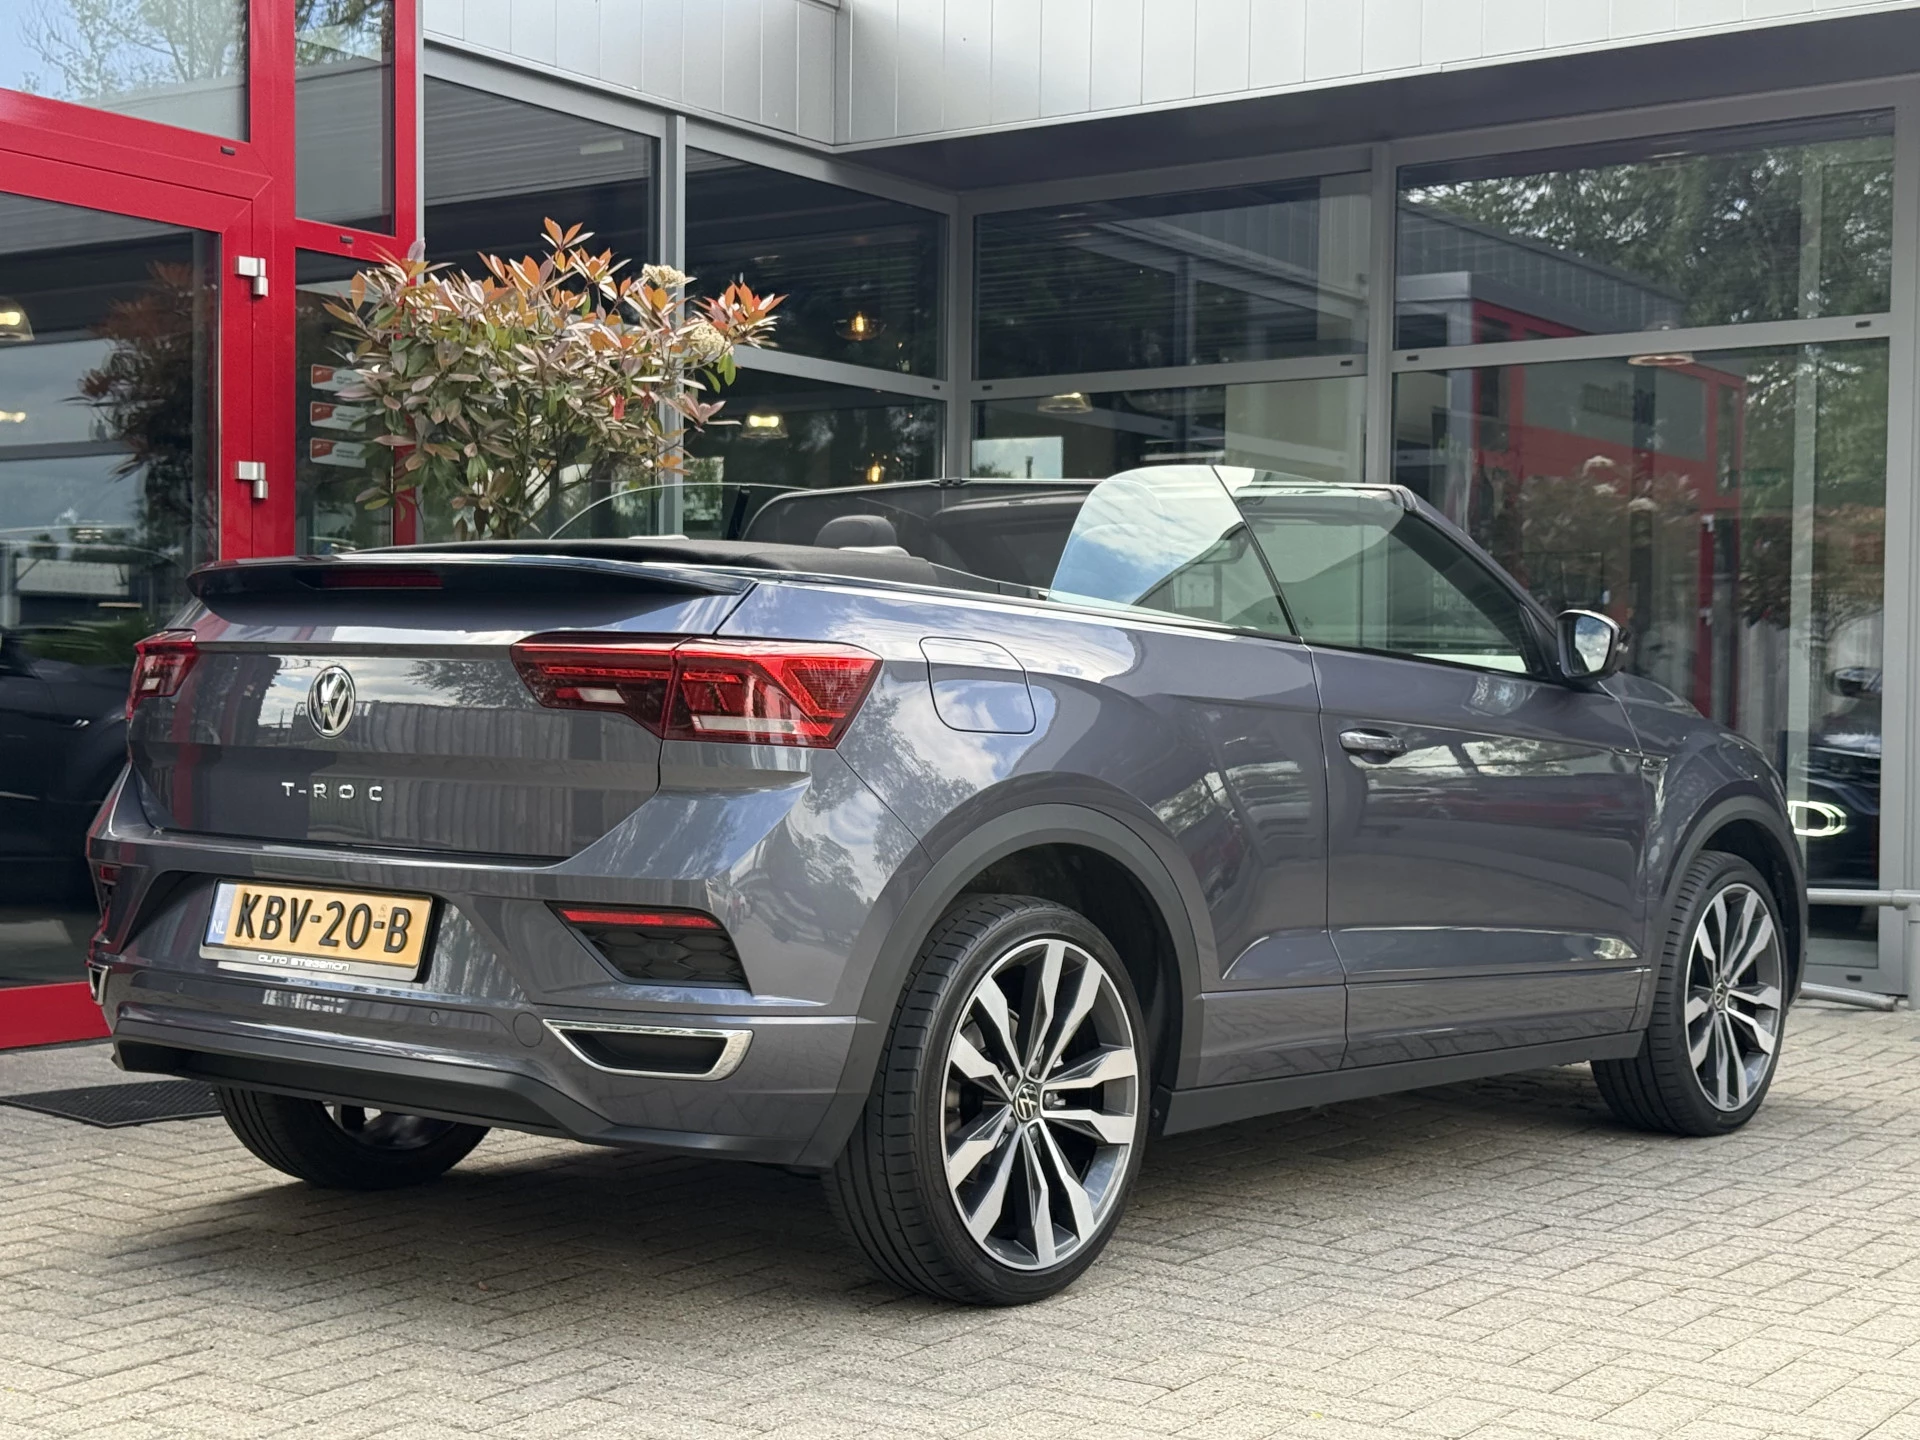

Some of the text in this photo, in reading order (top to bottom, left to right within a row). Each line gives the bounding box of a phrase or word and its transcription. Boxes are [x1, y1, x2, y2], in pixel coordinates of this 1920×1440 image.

[281, 781, 383, 802] T-ROC
[211, 919, 225, 935] NL
[234, 892, 412, 954] KBV-20-B
